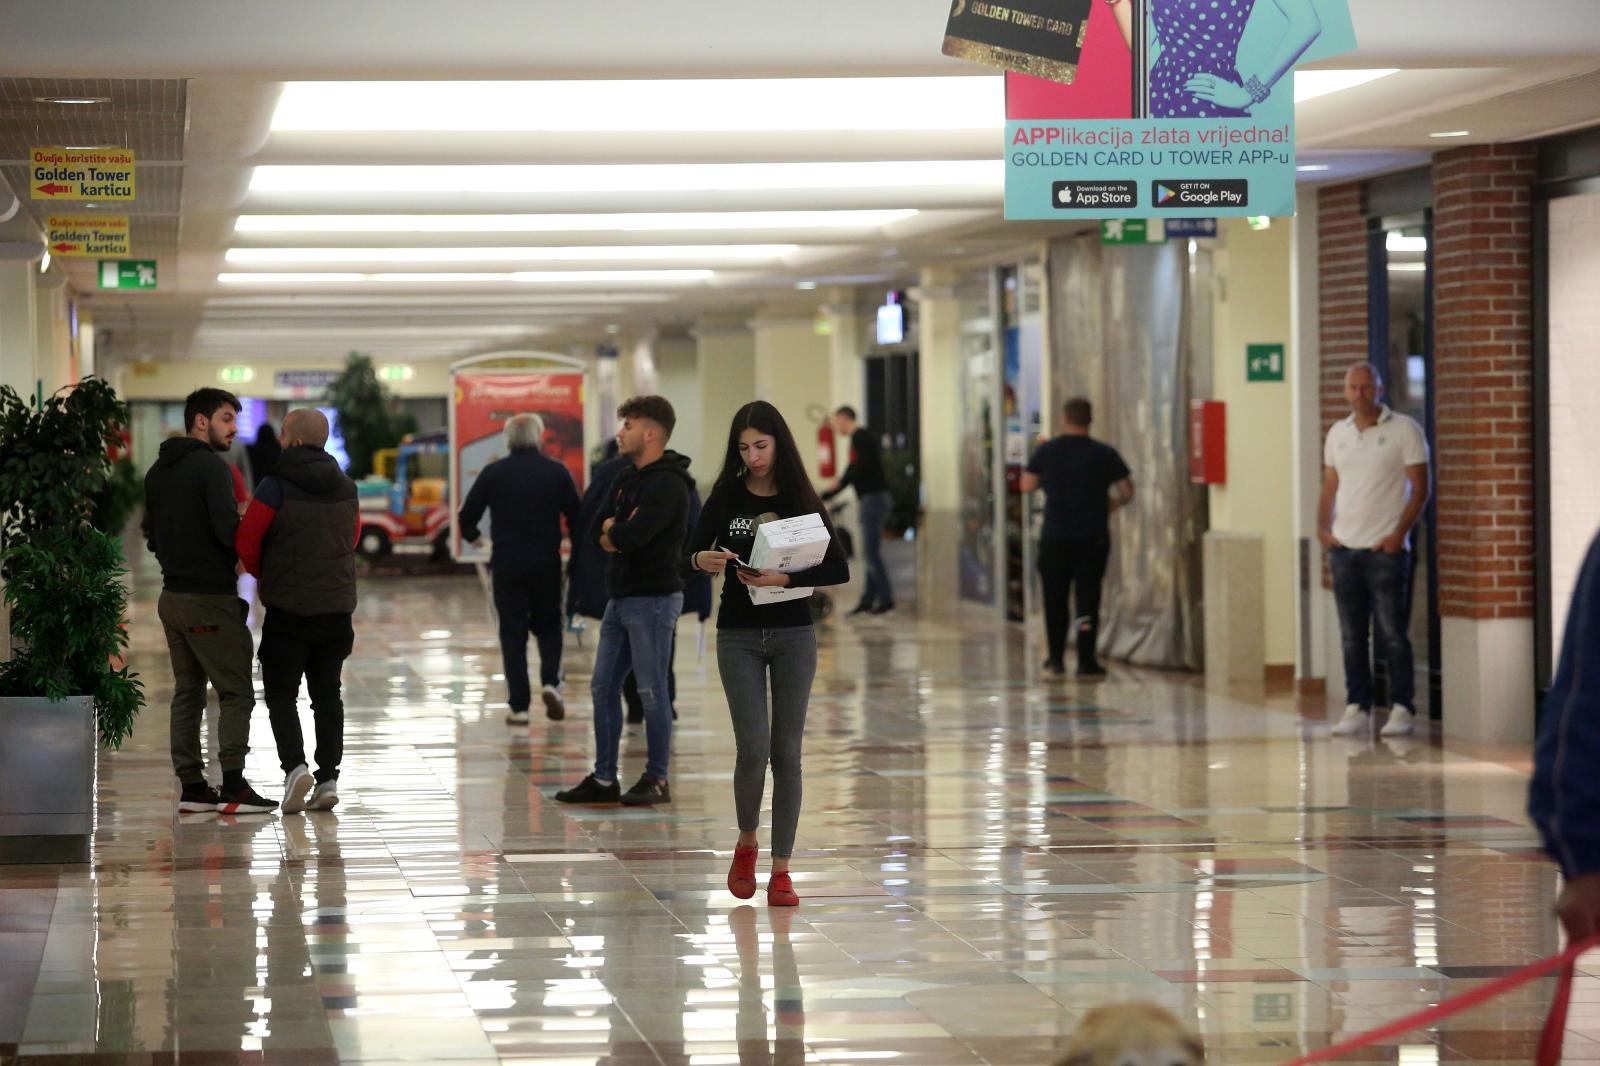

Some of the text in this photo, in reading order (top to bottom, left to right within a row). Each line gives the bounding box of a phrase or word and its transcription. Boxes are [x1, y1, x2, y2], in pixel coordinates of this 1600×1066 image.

[971, 1, 1073, 36] GOLDEN TOWER CARD
[990, 50, 1030, 67] TOWER
[1012, 124, 1289, 149] APPlikacija zlata vrijedna!
[34, 152, 131, 166] Ovdje koristite vašu
[1011, 149, 1289, 167] GOLDEN CARD U TOWER APP-u
[34, 167, 131, 181] Golden Tower
[80, 182, 131, 196] karticu
[1076, 192, 1131, 205] App Store
[1180, 190, 1242, 204] Google Play
[50, 230, 126, 241] Golden Tower
[86, 243, 127, 253] karticu
